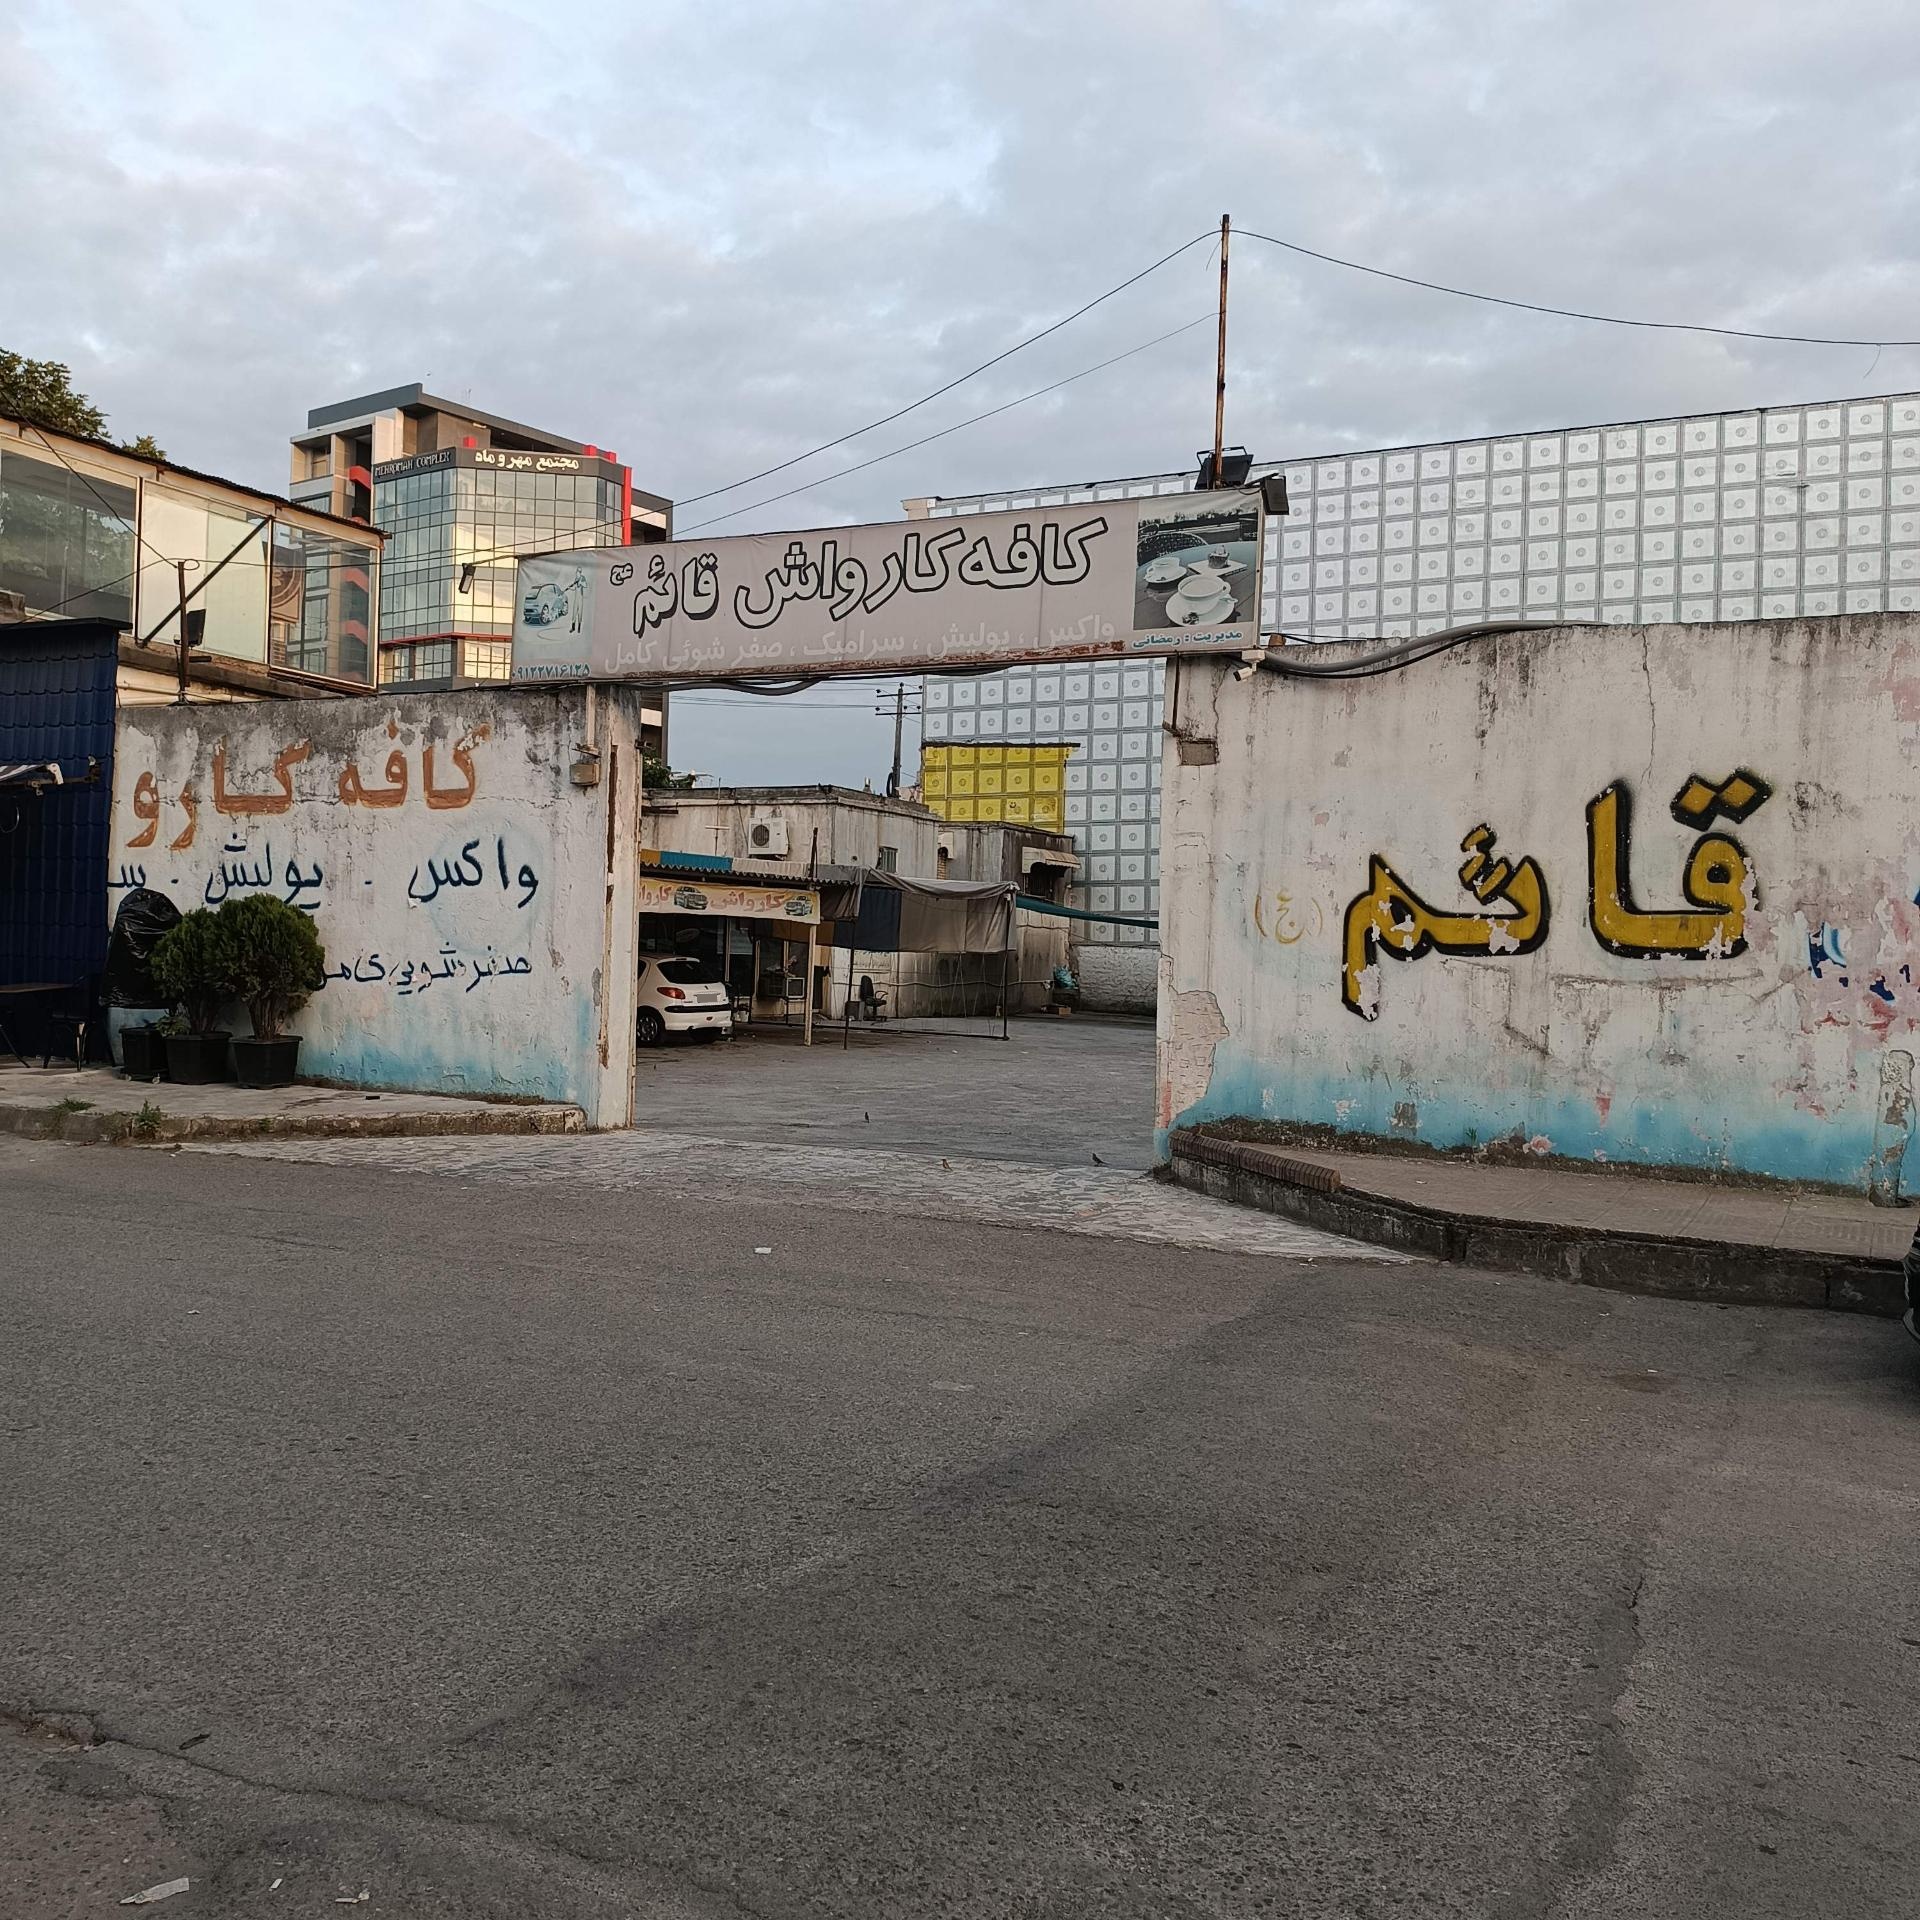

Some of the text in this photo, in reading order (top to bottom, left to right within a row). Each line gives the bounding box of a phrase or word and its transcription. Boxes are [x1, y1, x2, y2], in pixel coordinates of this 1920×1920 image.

[416, 451, 450, 468] COMPLEX
[475, 449, 580, 471] مجتمع مهر و ماه
[959, 517, 1108, 590] کافه
[633, 553, 720, 639] قائم
[803, 630, 905, 662] سرامیک
[1033, 614, 1115, 650] واکس
[1132, 634, 1181, 649] رمضانی
[1193, 629, 1243, 643] مدیریت
[604, 640, 659, 674] کامل
[731, 637, 784, 667] صفر
[338, 719, 491, 810] کافه
[407, 837, 540, 909] واکس
[1342, 767, 1773, 1021] قائم
